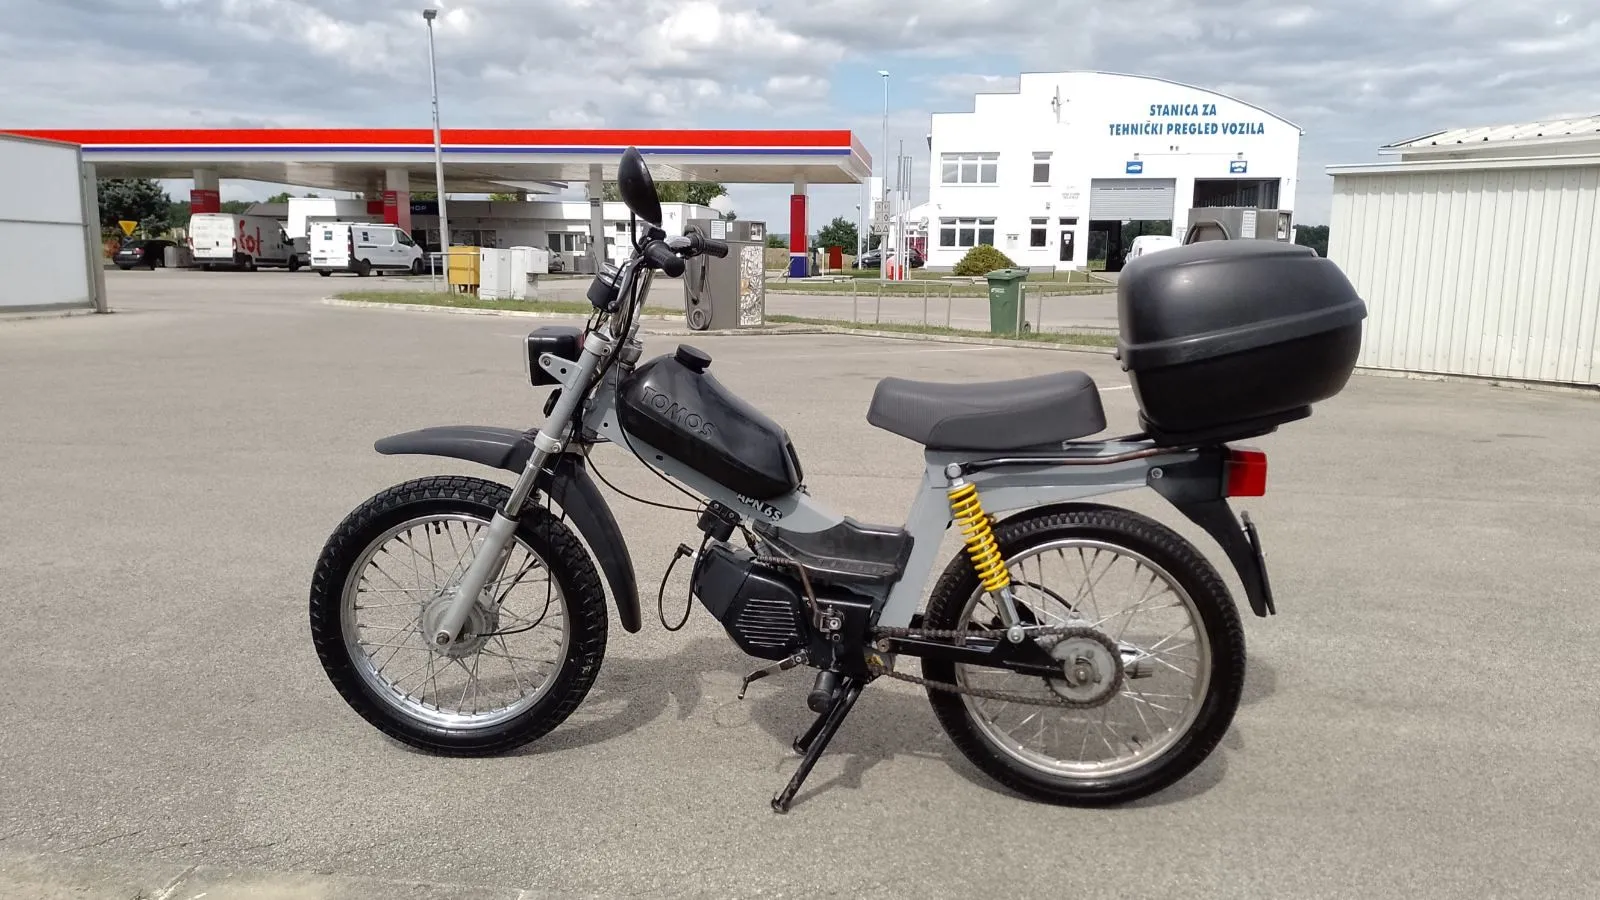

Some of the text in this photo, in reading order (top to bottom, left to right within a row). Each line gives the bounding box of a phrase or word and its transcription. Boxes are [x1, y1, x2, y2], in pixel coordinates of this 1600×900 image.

[1150, 104, 1217, 116] STANICA ZA
[1109, 120, 1265, 136] TEHNIČKI PREGLED VOZILA
[642, 386, 715, 438] TOMOS
[764, 506, 781, 520] 6S
